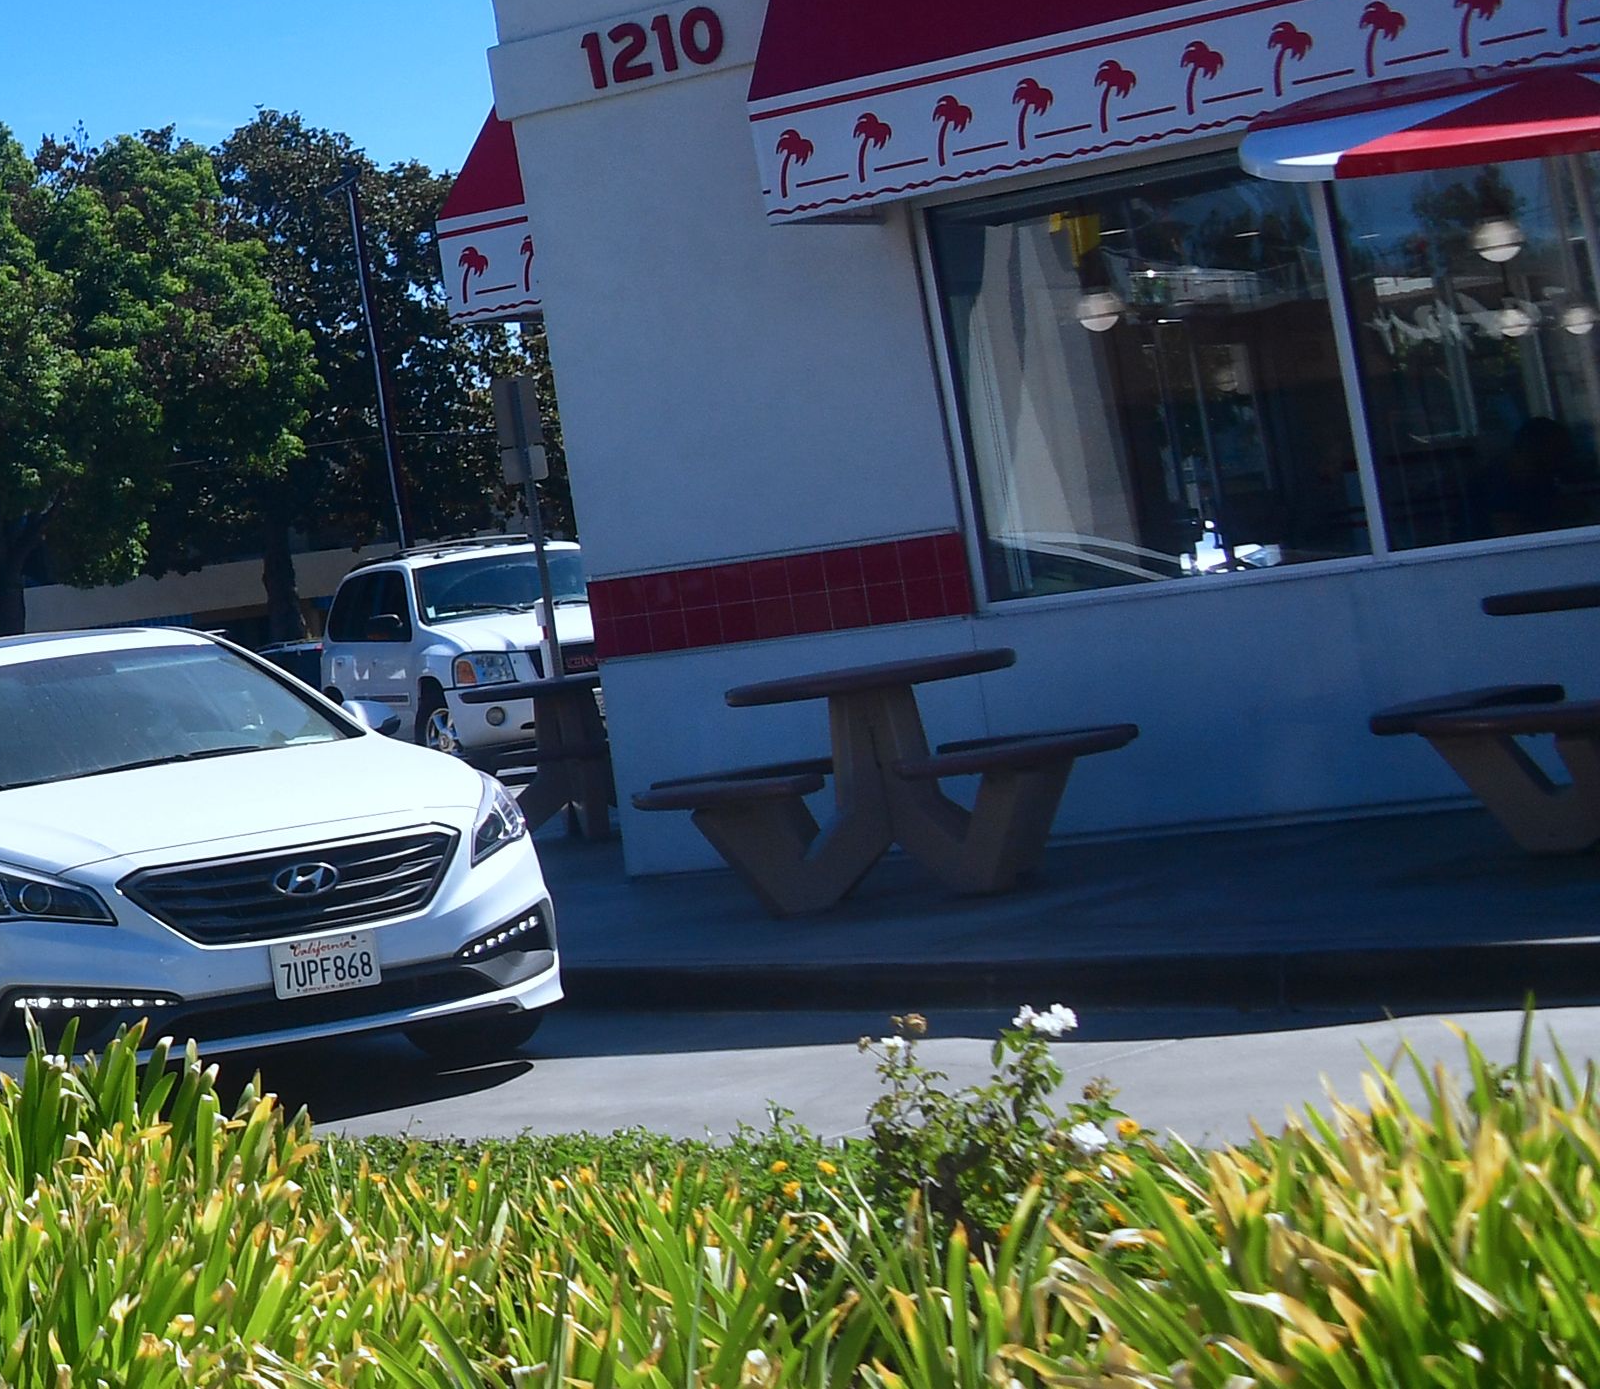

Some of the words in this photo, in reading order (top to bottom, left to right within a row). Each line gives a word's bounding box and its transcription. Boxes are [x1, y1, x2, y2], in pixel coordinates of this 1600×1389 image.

[580, 6, 724, 90] 1210
[293, 940, 357, 958] California
[280, 951, 373, 990] 7UPF868
